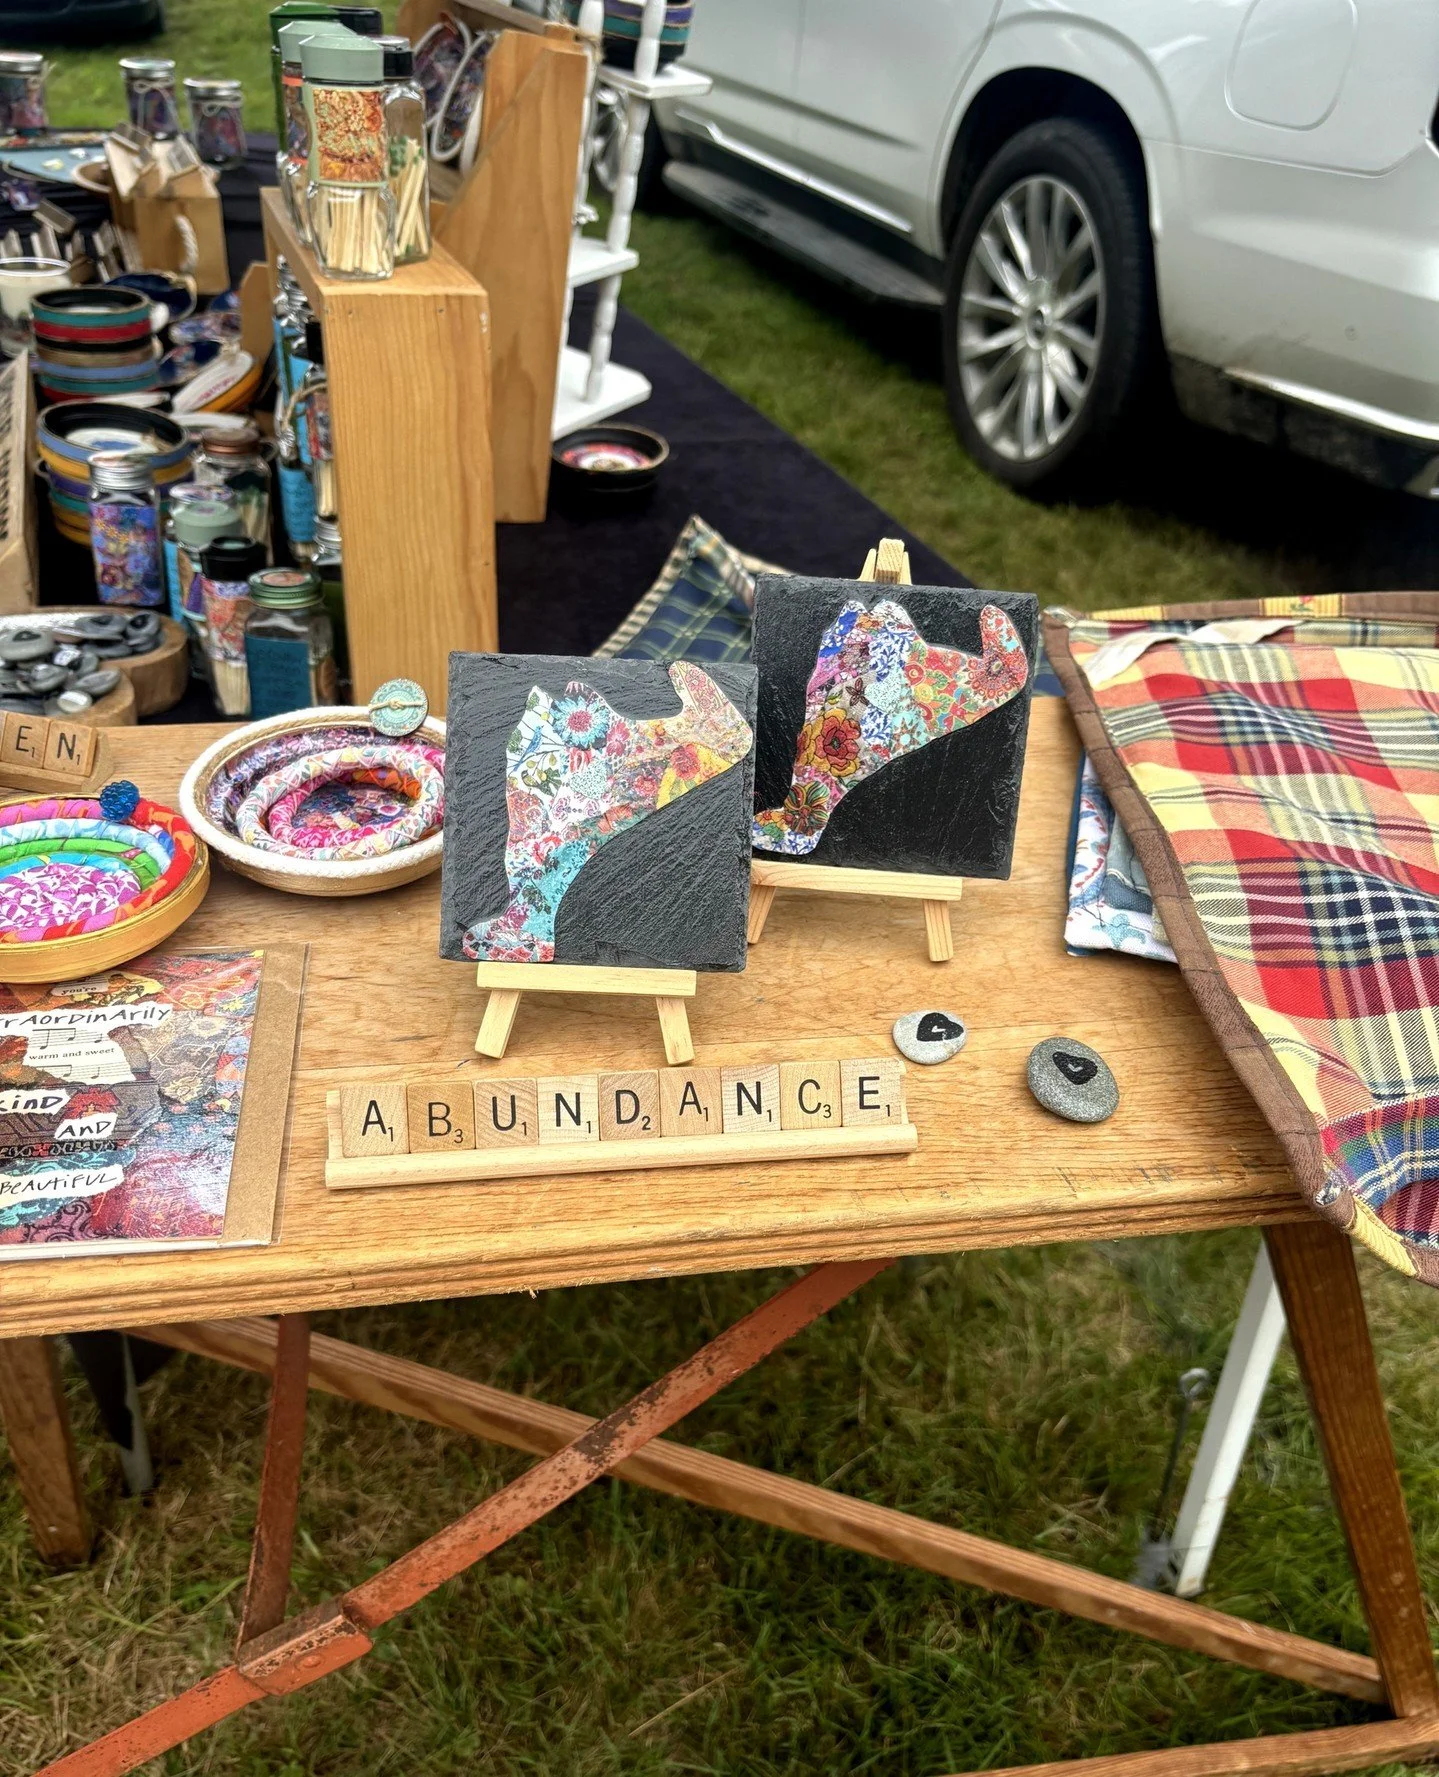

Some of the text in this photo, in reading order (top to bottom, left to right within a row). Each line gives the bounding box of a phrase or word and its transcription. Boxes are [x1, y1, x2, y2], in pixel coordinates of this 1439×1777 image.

[61, 986, 97, 996] you're
[0, 1006, 171, 1029] rAorDinArily
[28, 1047, 116, 1061] warm and sweet
[361, 1076, 882, 1137] ABUNDANCE
